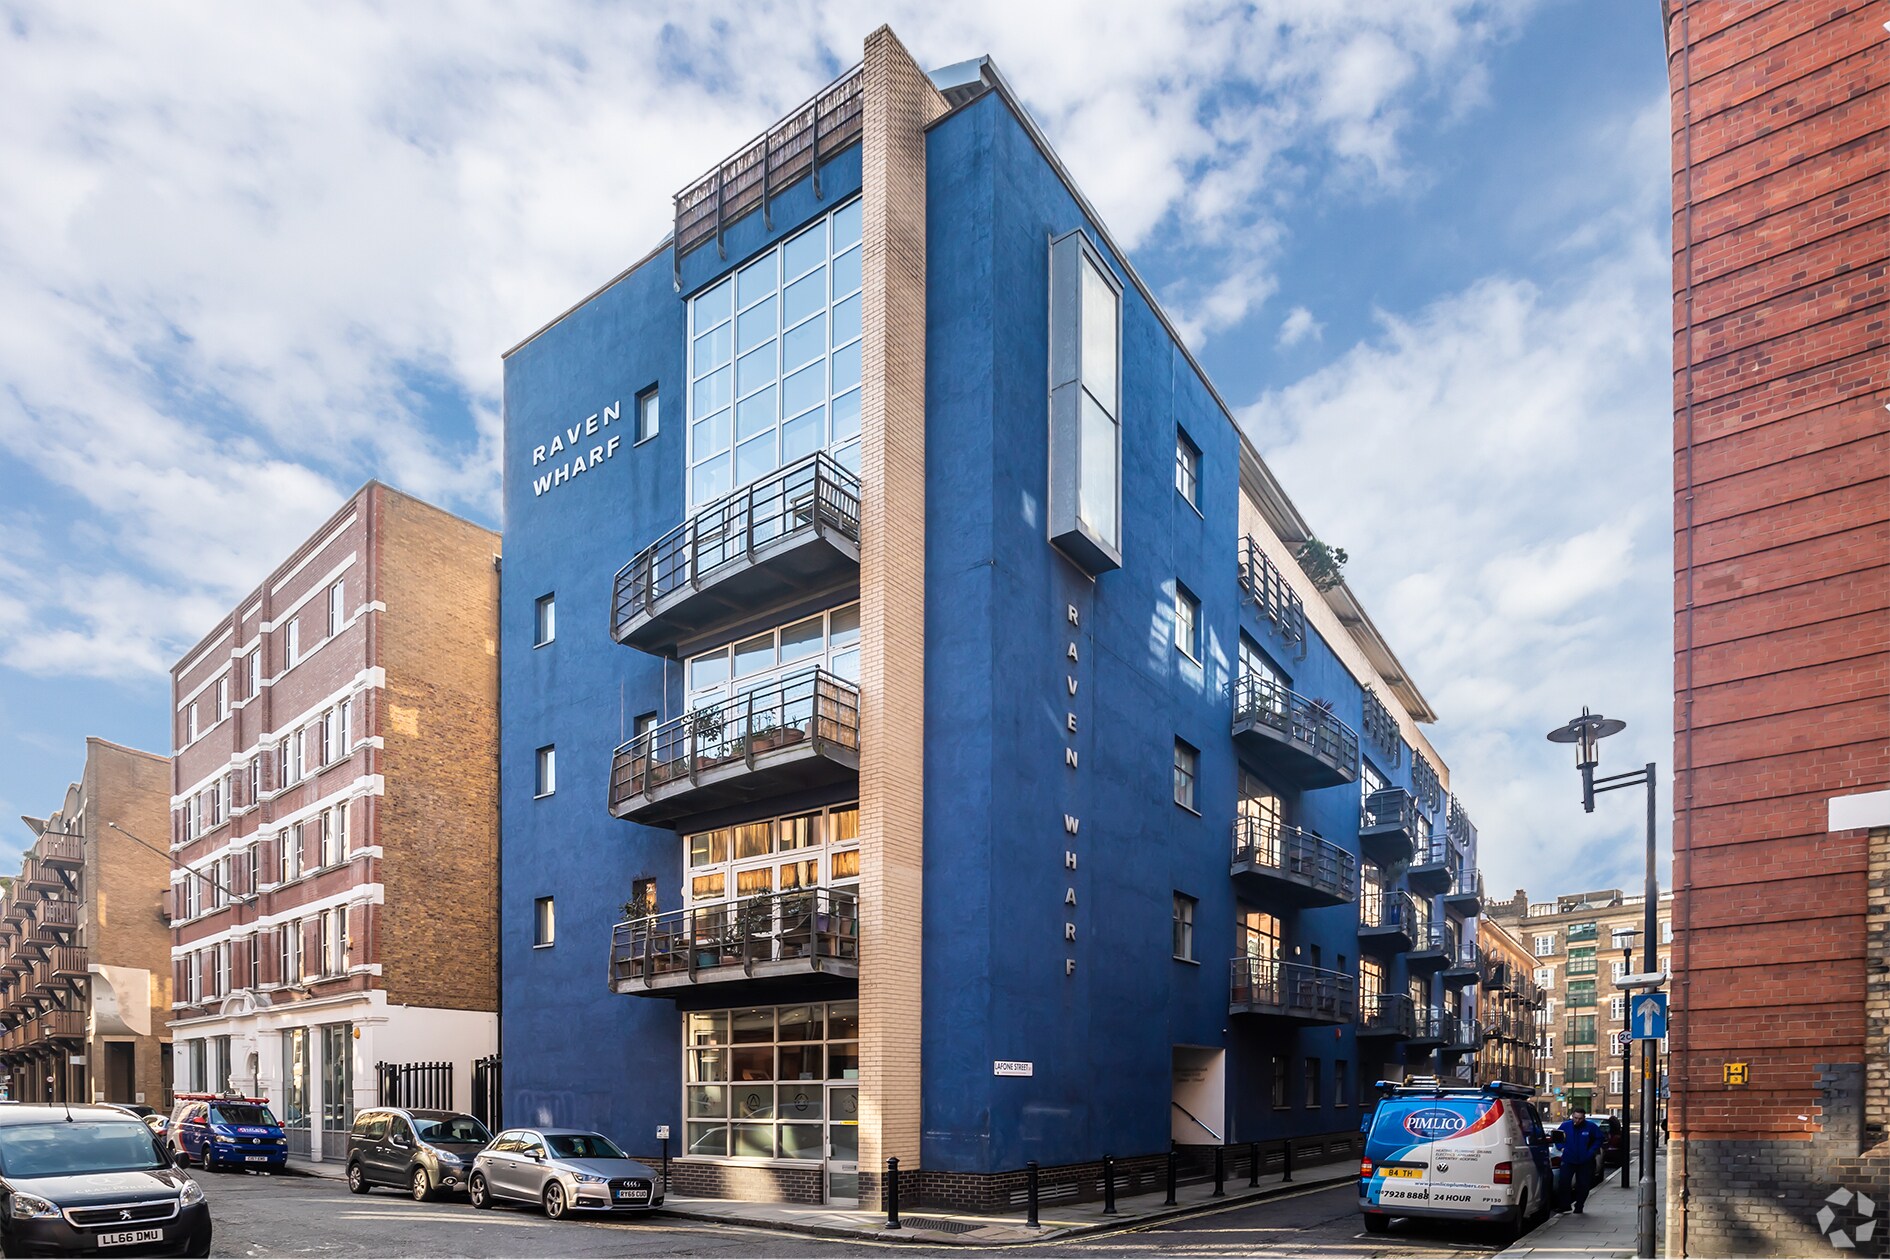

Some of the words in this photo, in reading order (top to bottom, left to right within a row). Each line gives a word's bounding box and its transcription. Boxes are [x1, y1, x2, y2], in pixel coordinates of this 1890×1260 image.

[532, 400, 620, 467] RAVEN
[532, 435, 620, 497] WHARF
[1066, 603, 1080, 769] RAVEN
[1063, 813, 1080, 977] WHARF
[995, 1062, 1013, 1071] LAFONE
[1013, 1063, 1029, 1071] STREET
[1406, 1117, 1465, 1130] PIMLICO
[1402, 1170, 1413, 1178] TH
[1384, 1190, 1406, 1199] 7928
[1406, 1191, 1430, 1200] 8888
[1445, 1194, 1472, 1203] HOUR
[102, 1233, 133, 1245] LL66
[136, 1230, 158, 1242] DMU
